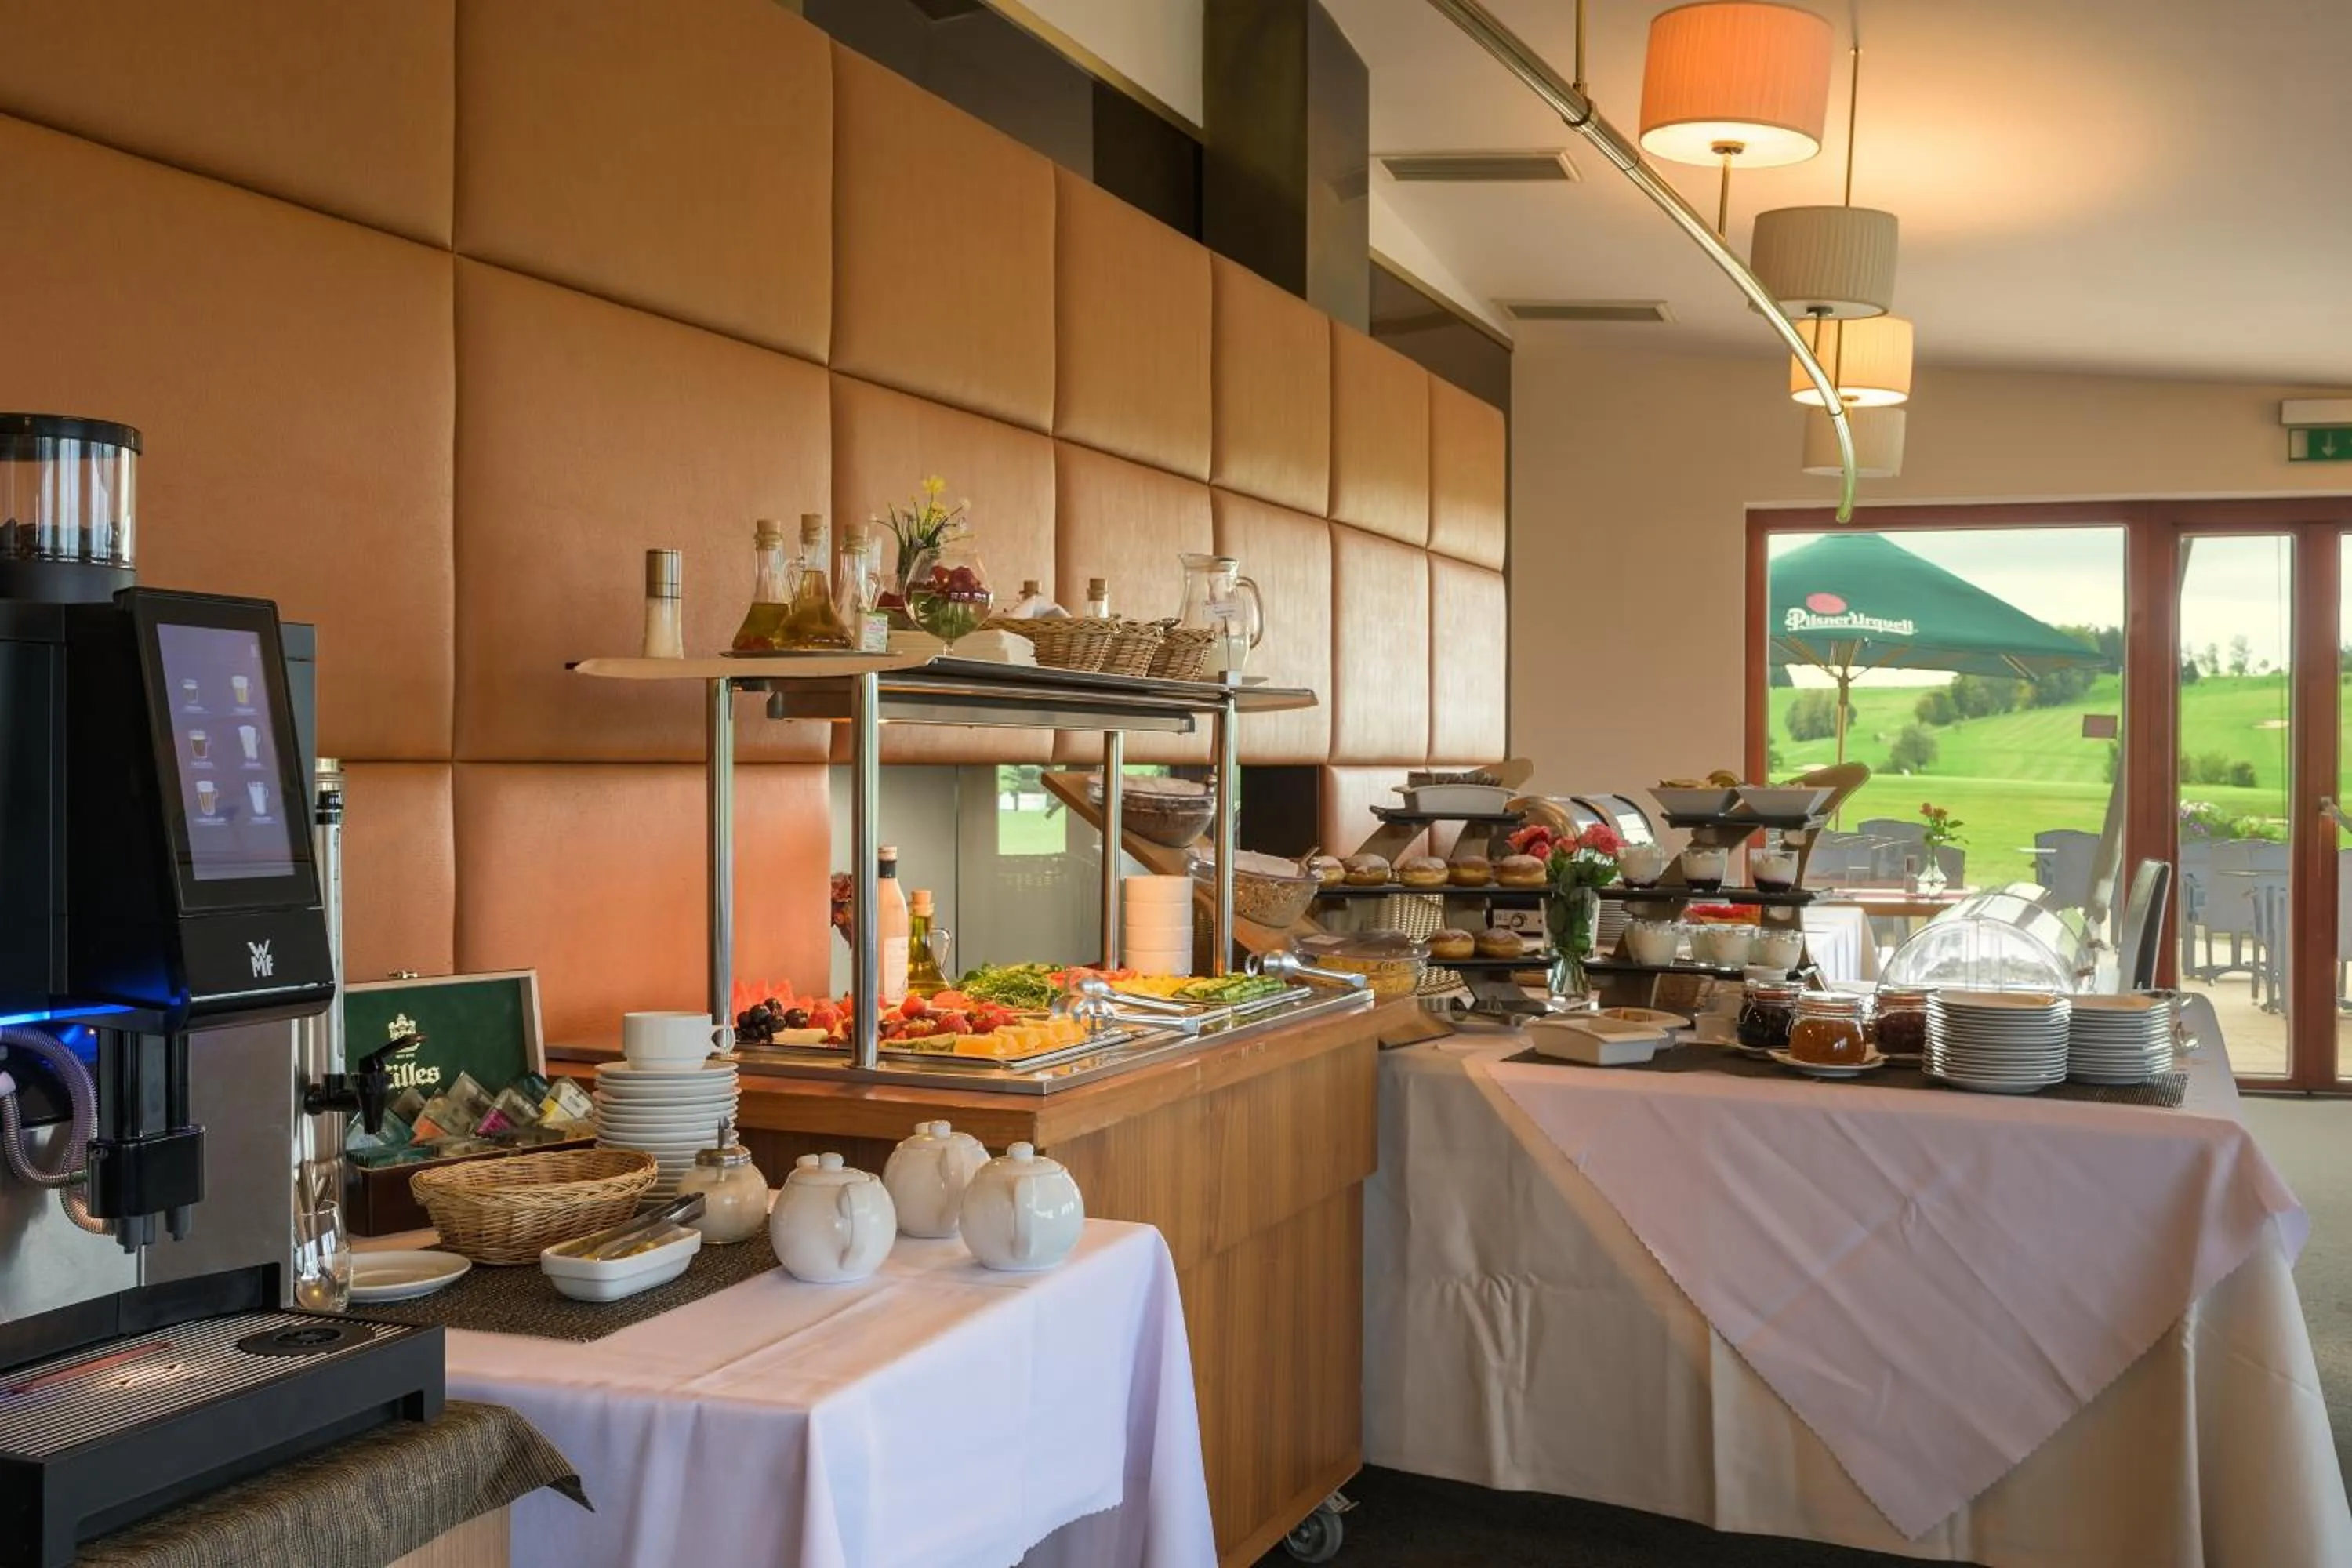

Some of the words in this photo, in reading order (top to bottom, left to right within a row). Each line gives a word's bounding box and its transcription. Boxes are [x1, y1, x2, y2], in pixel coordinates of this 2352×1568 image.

[1784, 608, 1849, 632] Pilsner
[1848, 611, 1915, 634] Urquell
[247, 939, 274, 978] WMF
